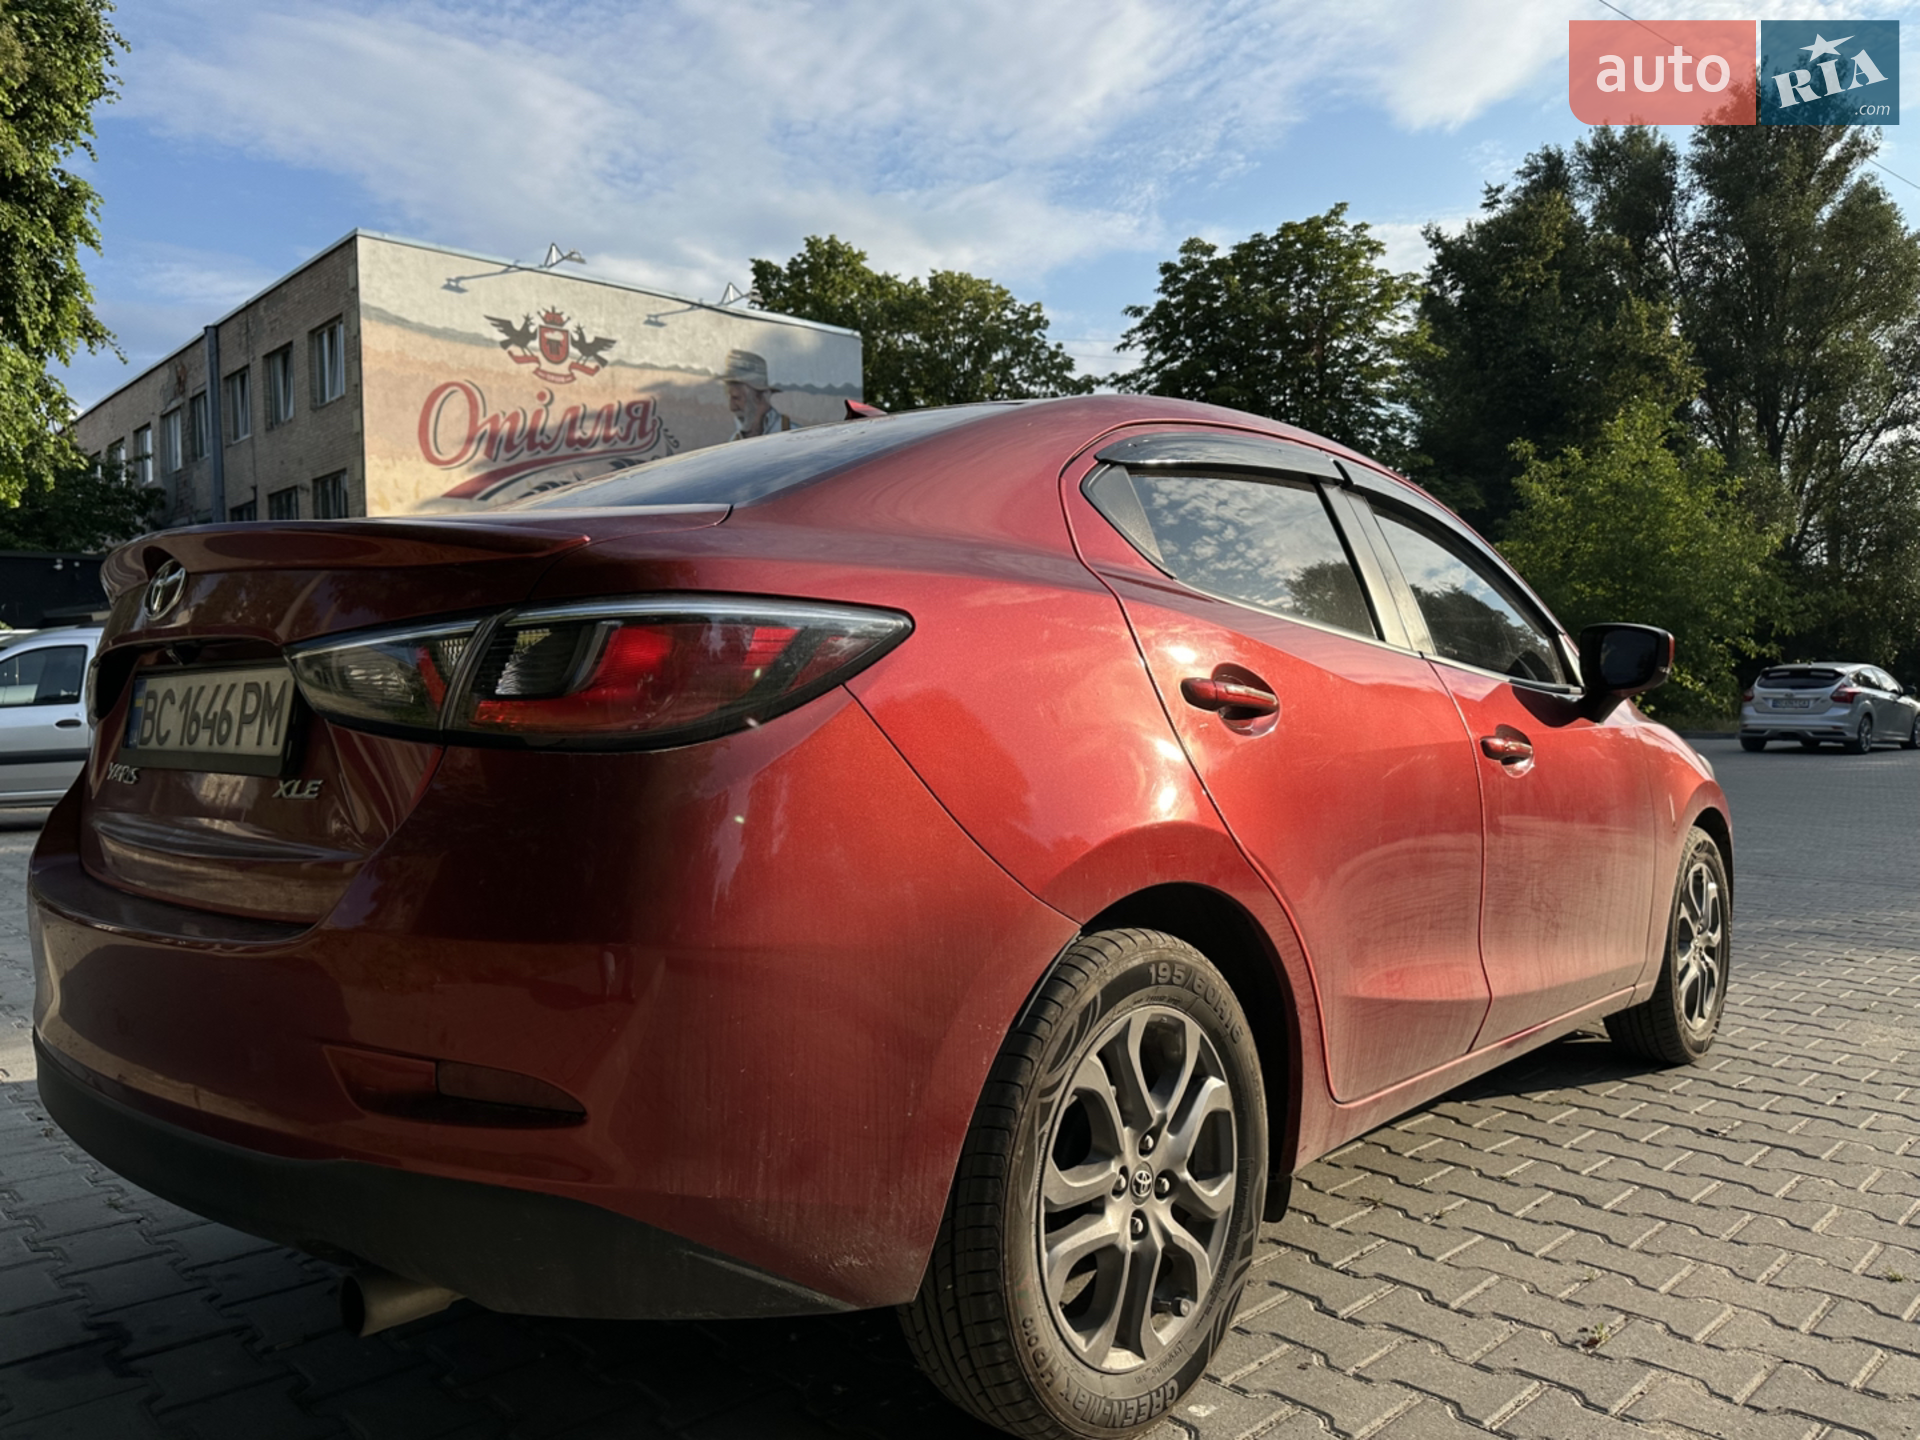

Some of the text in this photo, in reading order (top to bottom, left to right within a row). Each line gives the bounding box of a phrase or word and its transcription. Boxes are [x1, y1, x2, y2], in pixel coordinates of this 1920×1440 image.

[416, 378, 661, 468] Опілля
[138, 679, 288, 747] BC 1646 PM
[272, 779, 323, 799] XLE
[1147, 961, 1245, 1045] 195/60R16
